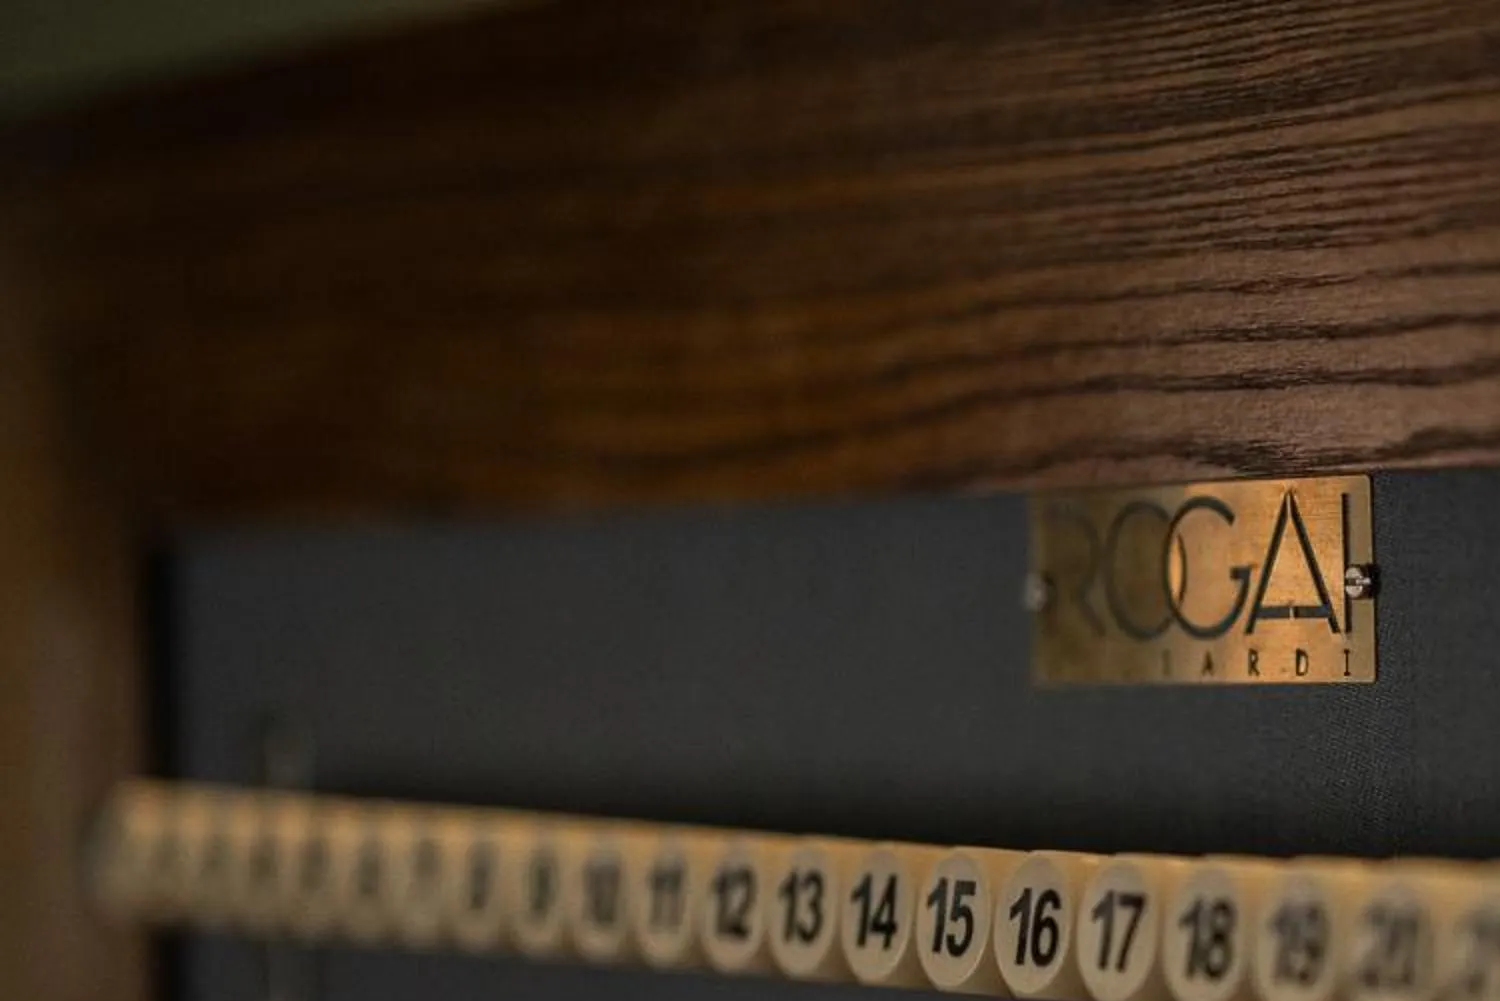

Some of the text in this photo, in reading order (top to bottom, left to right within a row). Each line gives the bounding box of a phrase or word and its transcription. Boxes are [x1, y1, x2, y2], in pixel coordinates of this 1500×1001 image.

[713, 863, 756, 938] 12
[778, 870, 824, 944] 13
[850, 873, 898, 951] 14
[926, 877, 977, 958] 15
[1008, 887, 1062, 968] 16
[1092, 890, 1148, 973] 17
[1178, 898, 1238, 982] 18
[1269, 902, 1329, 985] 19
